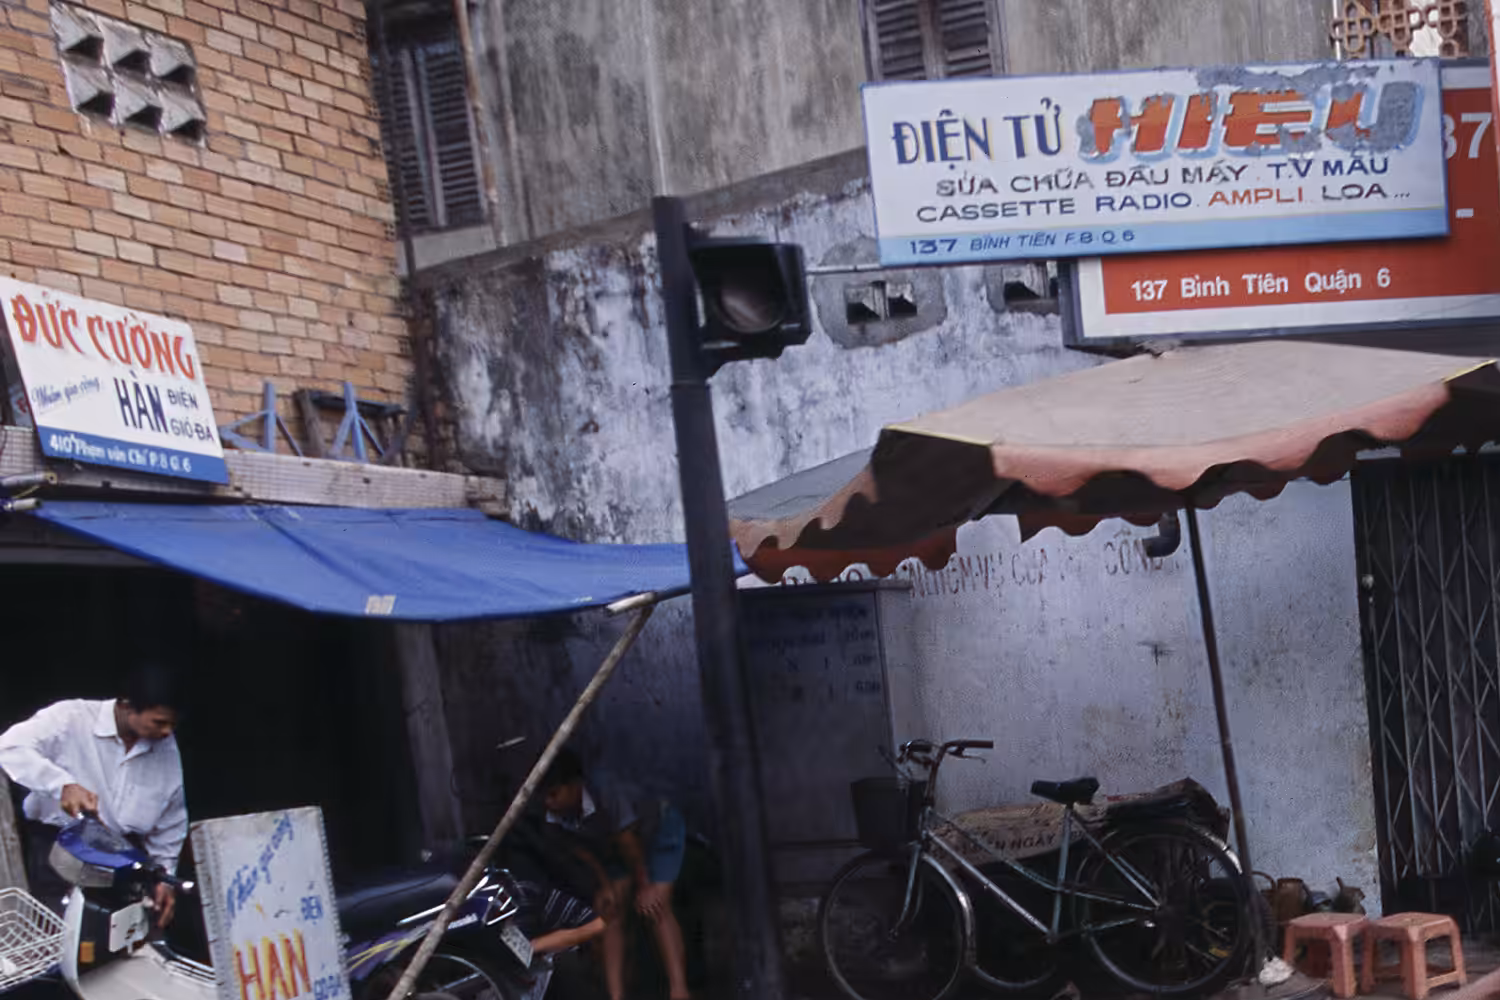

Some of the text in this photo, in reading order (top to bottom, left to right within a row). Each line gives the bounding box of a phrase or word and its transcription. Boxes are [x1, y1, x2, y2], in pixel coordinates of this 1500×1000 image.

[891, 109, 994, 170] ĐIỆN
[916, 198, 1076, 223] CASSETTE
[910, 238, 958, 255] 137
[1131, 267, 1391, 301] 137 Bình Tiên Quận 6
[113, 370, 169, 433] HÀN
